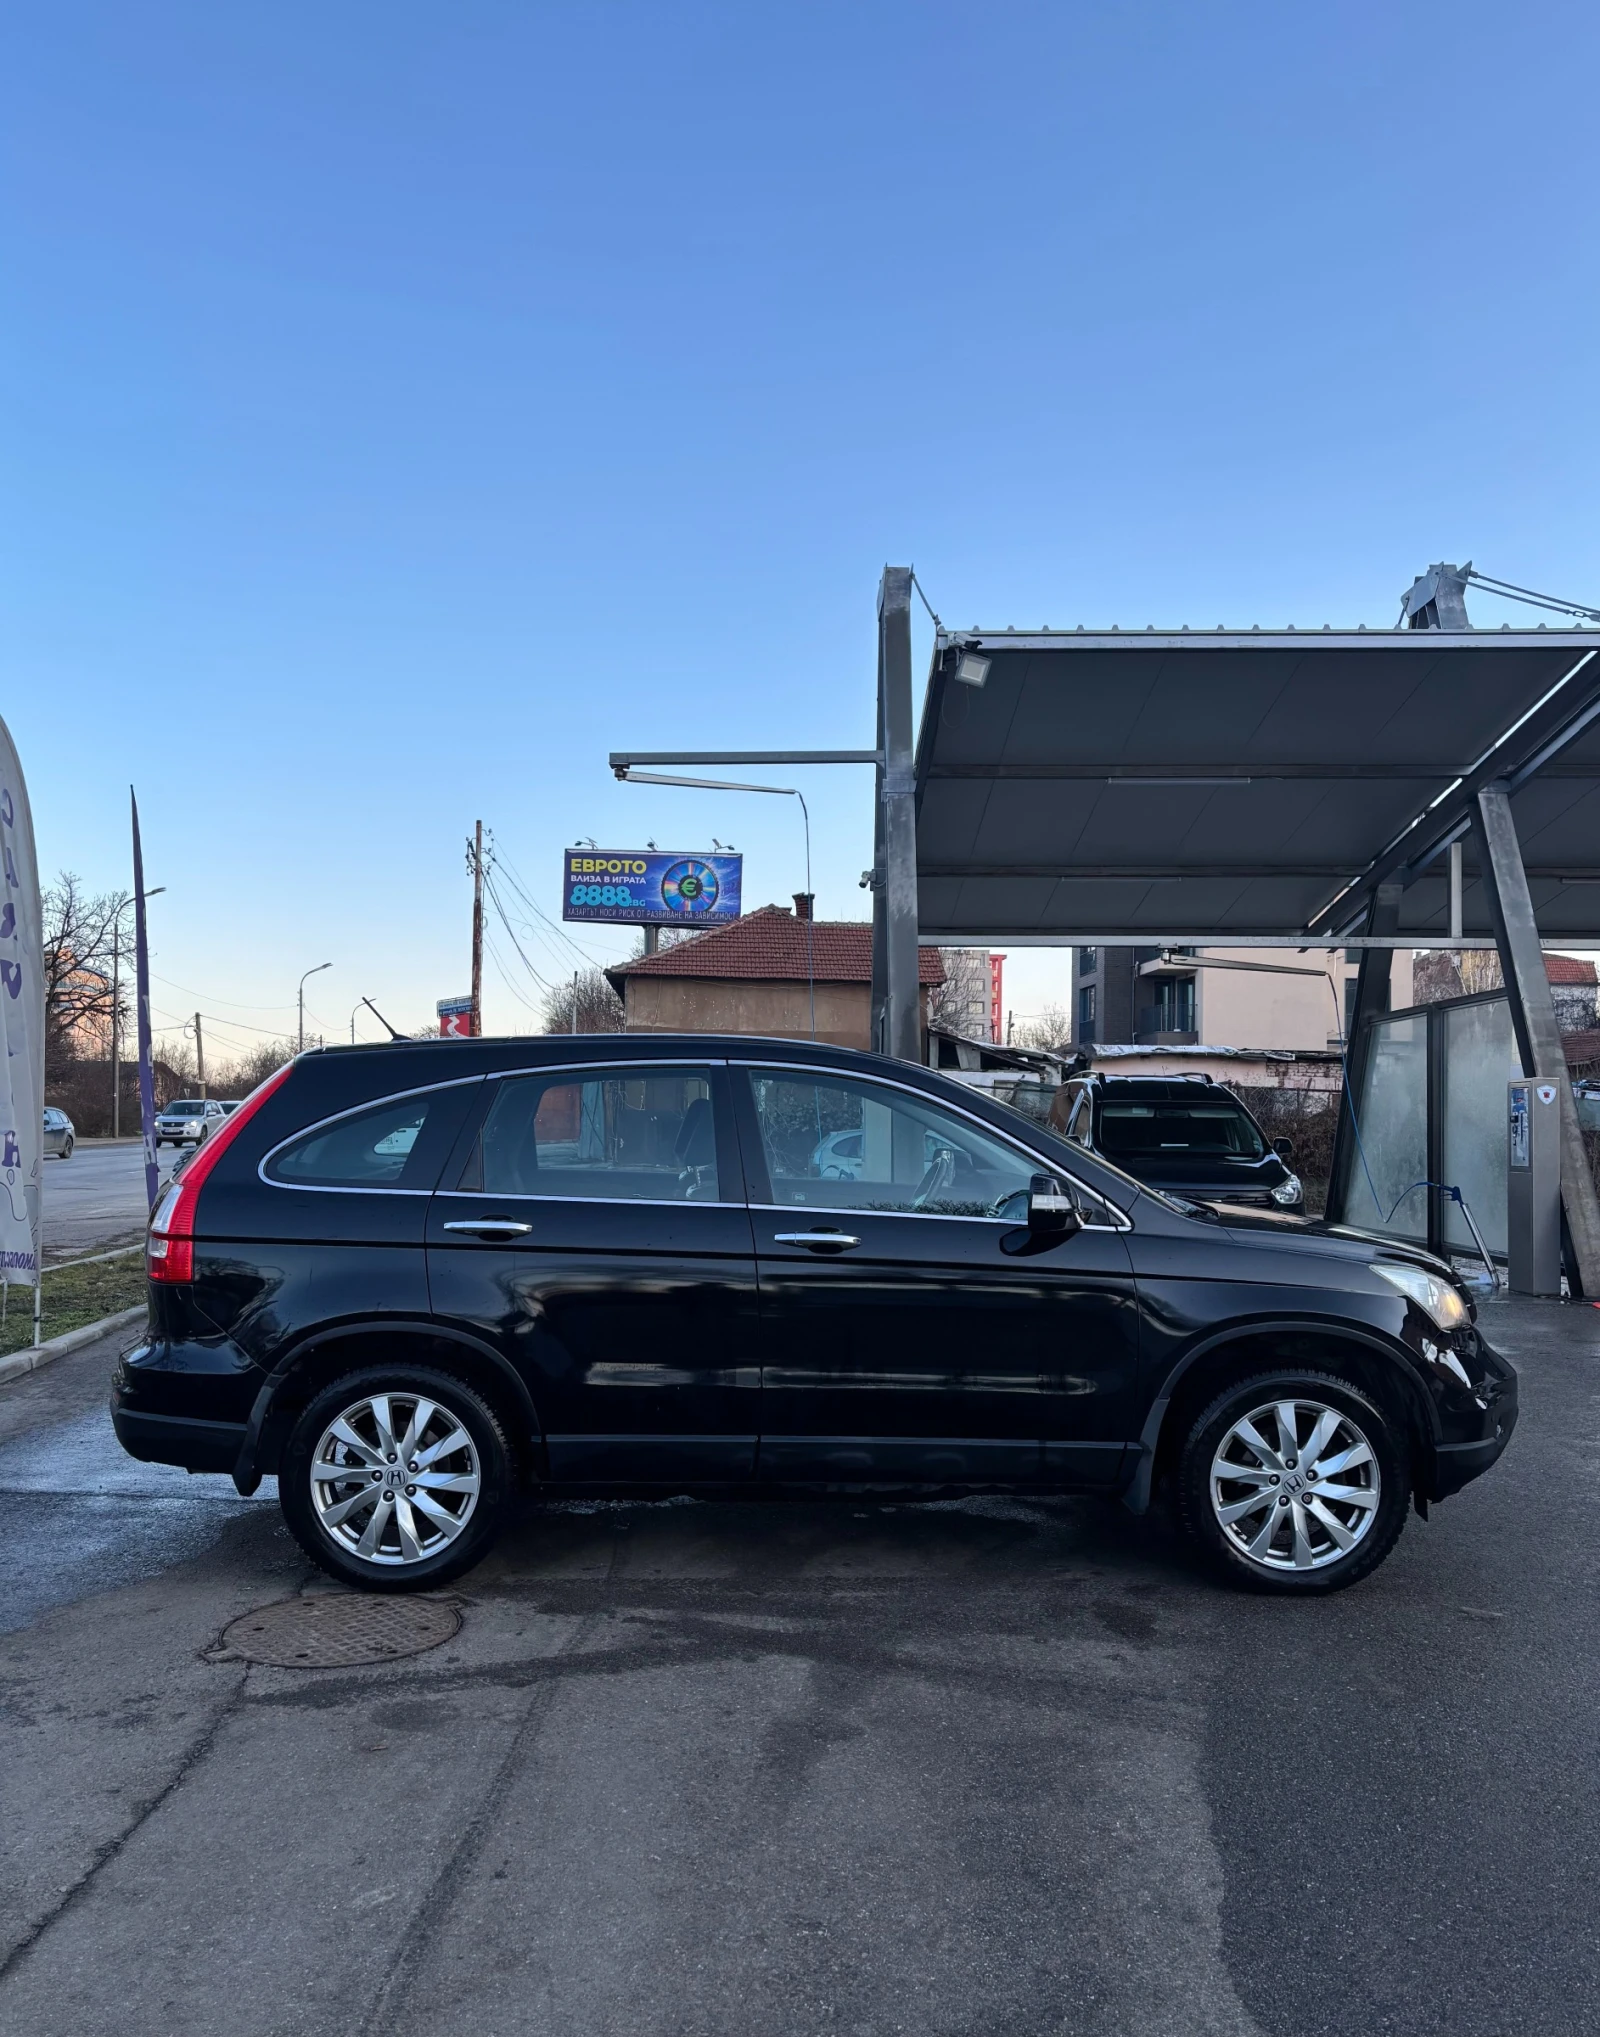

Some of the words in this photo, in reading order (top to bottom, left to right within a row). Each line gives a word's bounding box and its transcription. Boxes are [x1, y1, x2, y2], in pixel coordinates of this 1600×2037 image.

[571, 858, 647, 874] ЕВРОТО
[570, 875, 602, 883] ВЛИЗА
[604, 876, 610, 884] В
[612, 876, 647, 885] ИГРАТА
[568, 907, 597, 917] ХАЗАРТЪТ
[600, 908, 617, 917] НОСИ
[619, 909, 635, 918] РИСК
[636, 910, 645, 918] ОТ
[646, 910, 682, 920] РАЗВИВАНЕ
[684, 911, 693, 919] НА
[694, 911, 736, 920] ЗАВИСИМОСТ
